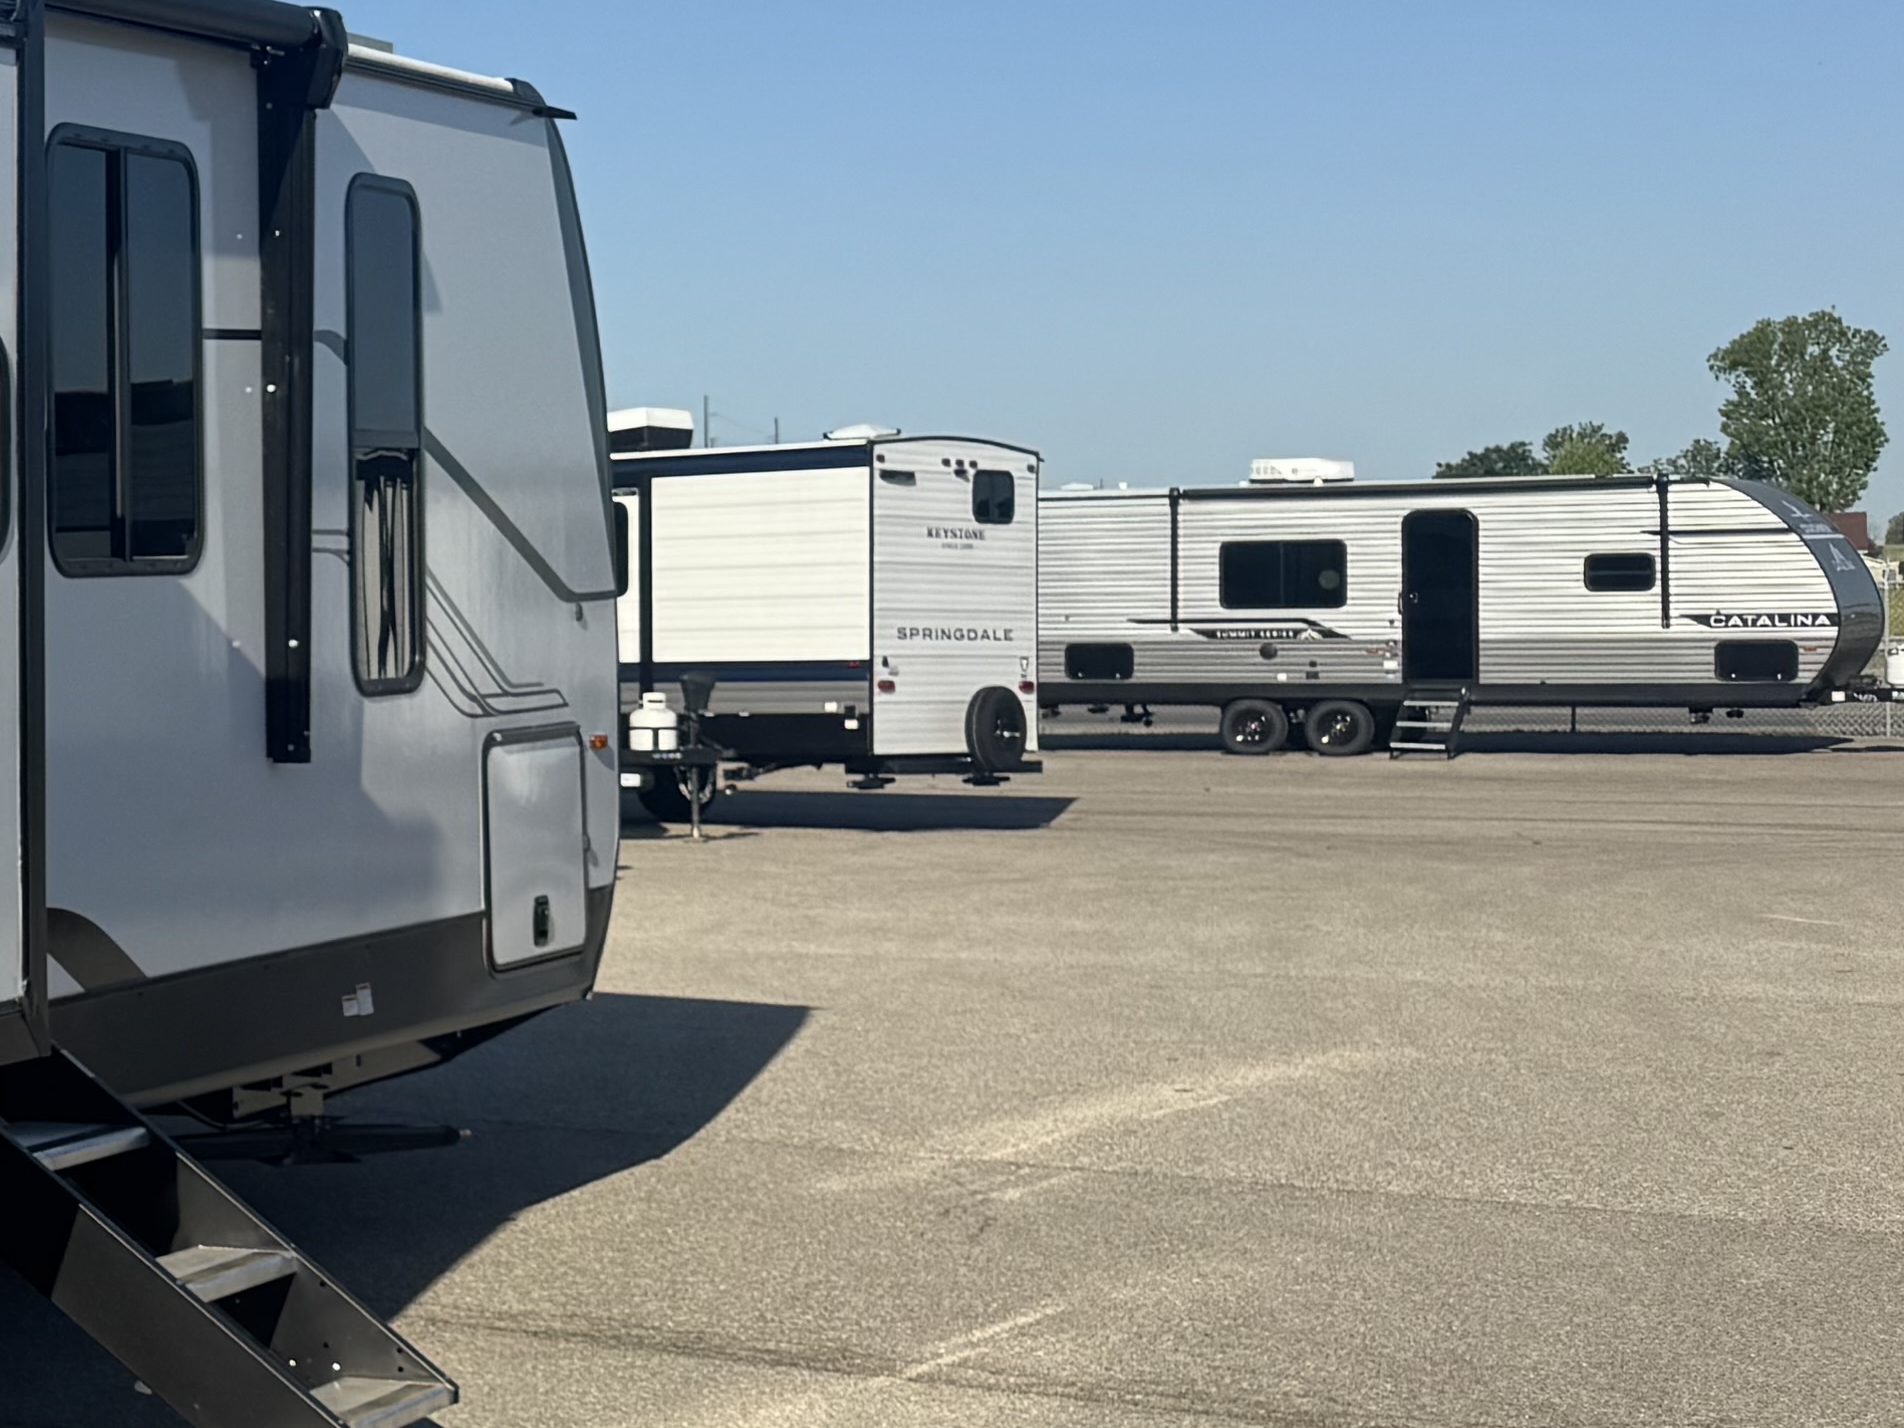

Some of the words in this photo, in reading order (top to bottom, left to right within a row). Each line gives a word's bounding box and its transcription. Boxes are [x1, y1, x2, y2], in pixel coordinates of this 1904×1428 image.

[926, 527, 986, 540] KEYSTONE
[1709, 614, 1832, 627] CATALINA
[896, 627, 1014, 642] SPRINGDALE
